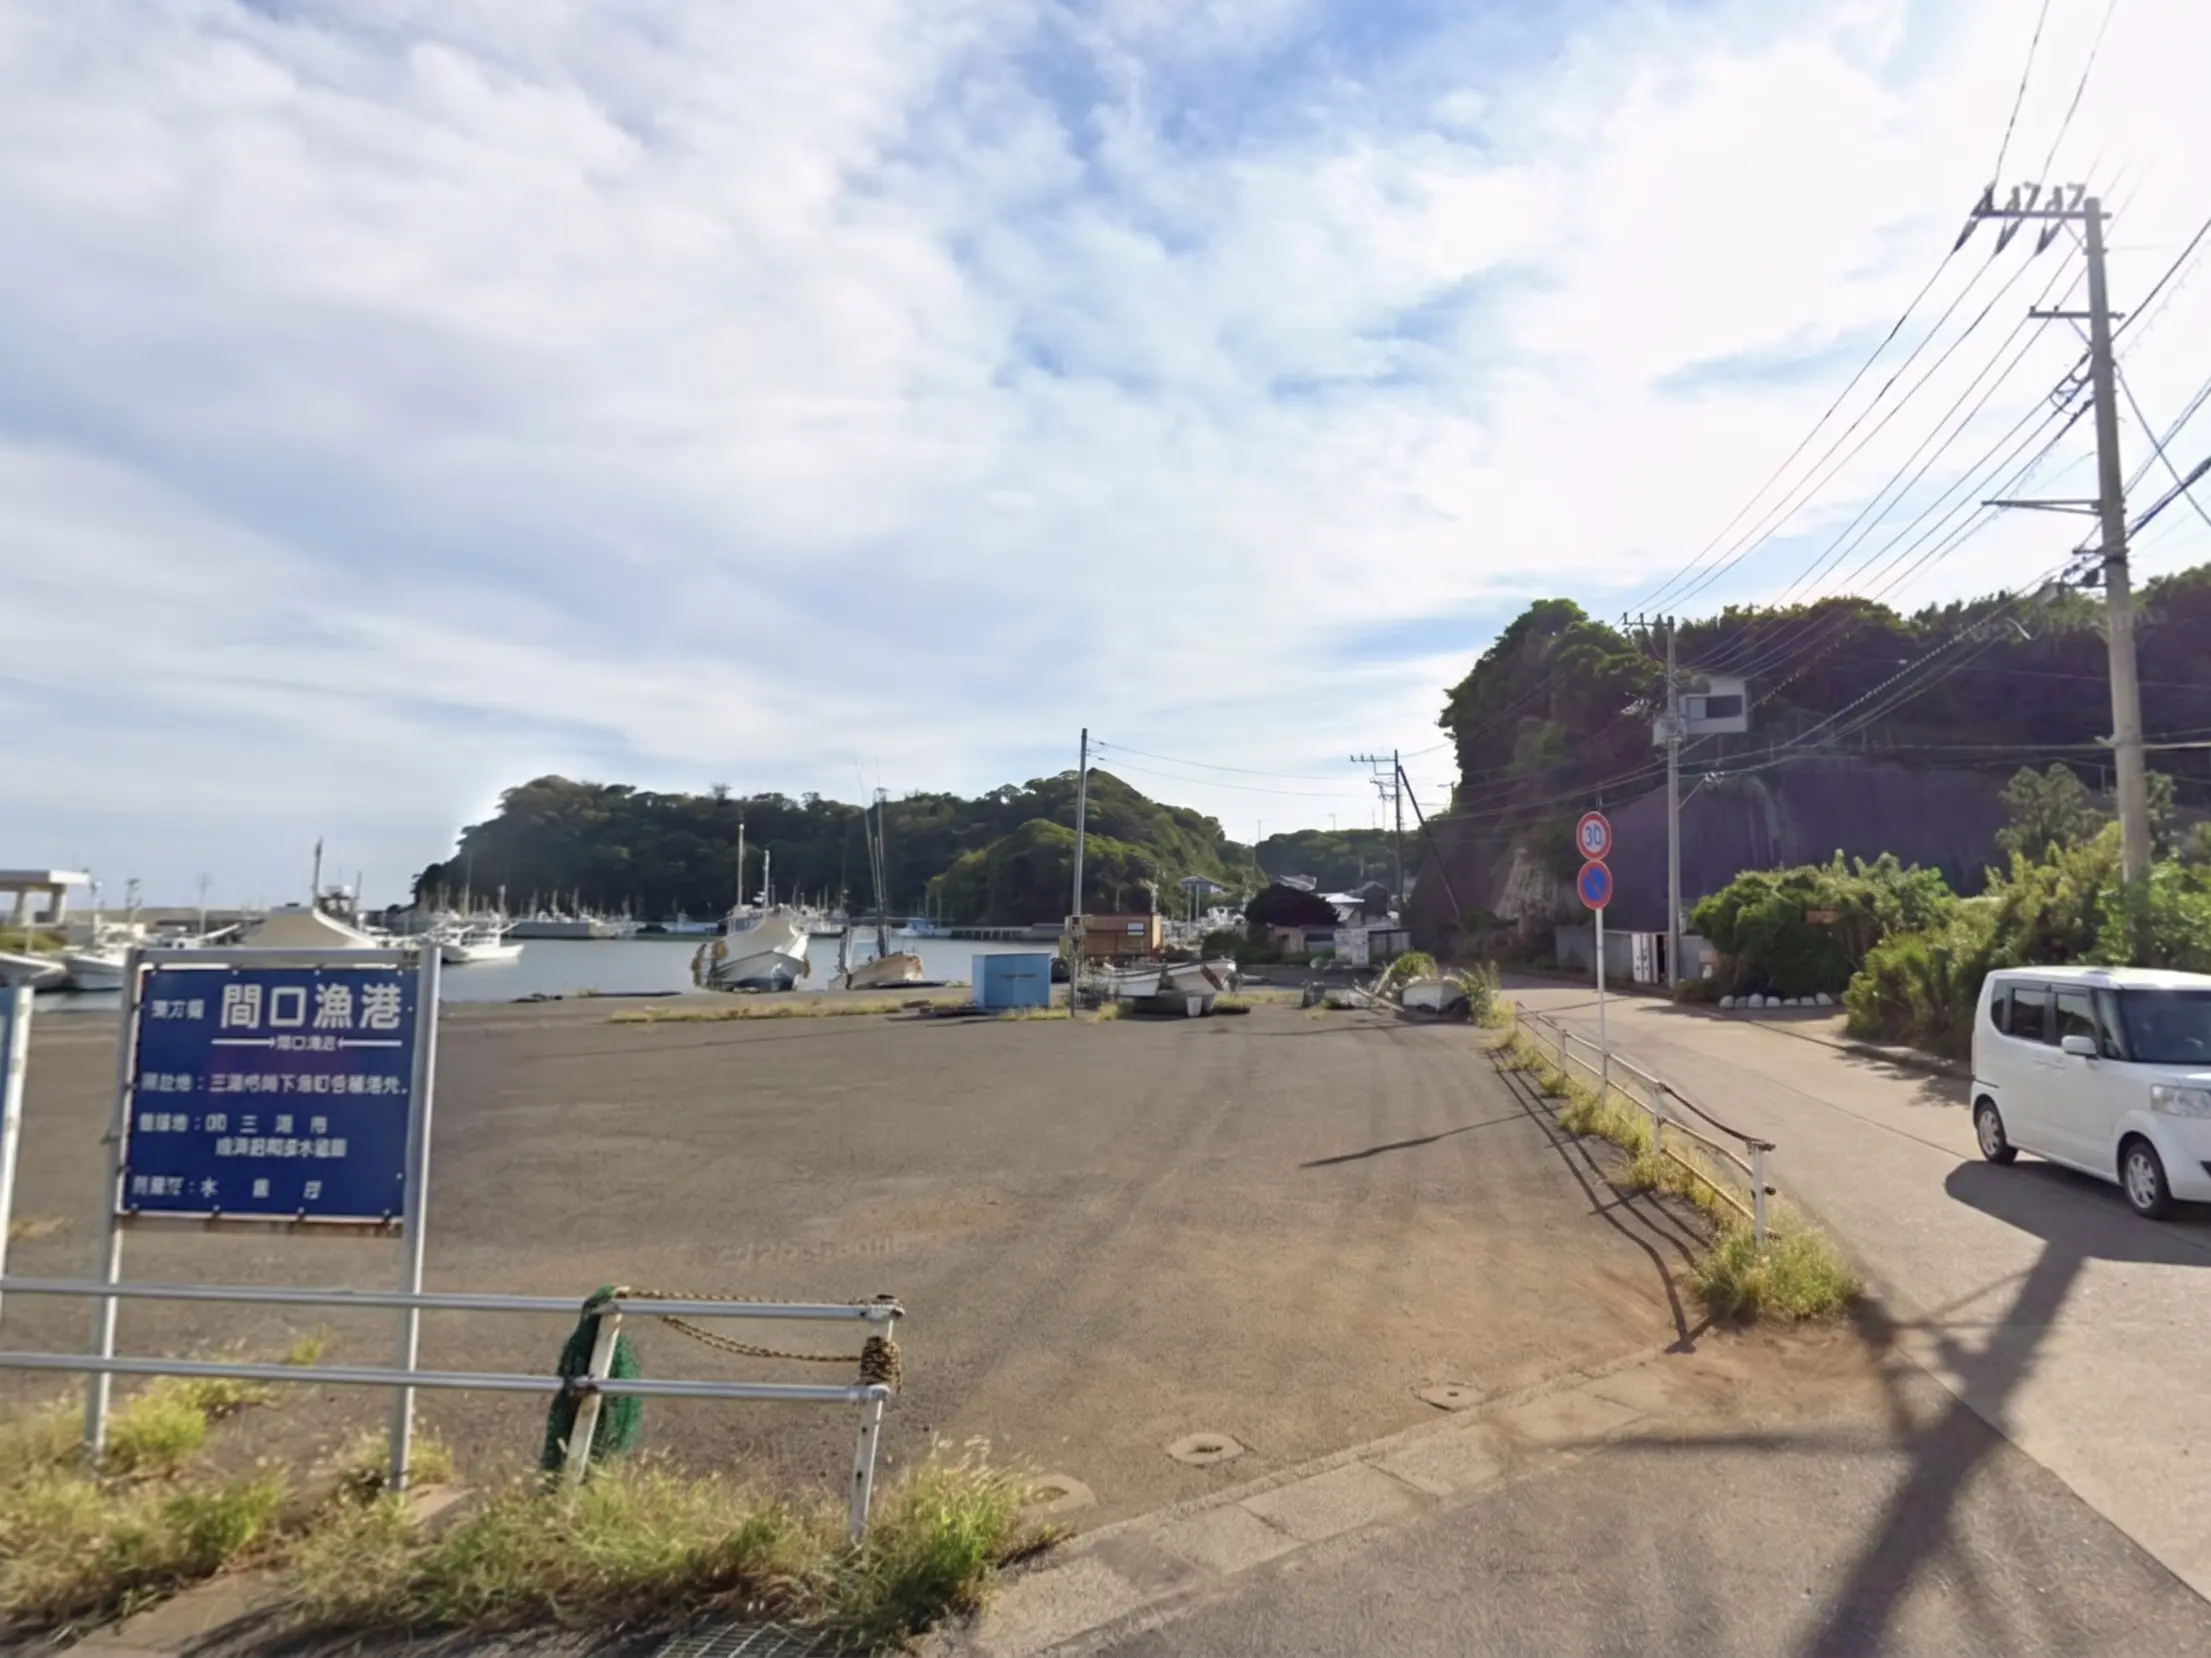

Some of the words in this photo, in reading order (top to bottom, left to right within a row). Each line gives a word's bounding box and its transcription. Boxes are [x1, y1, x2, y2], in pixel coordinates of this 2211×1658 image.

[1585, 824, 1602, 846] 30
[220, 982, 402, 1029] 間口漁港
